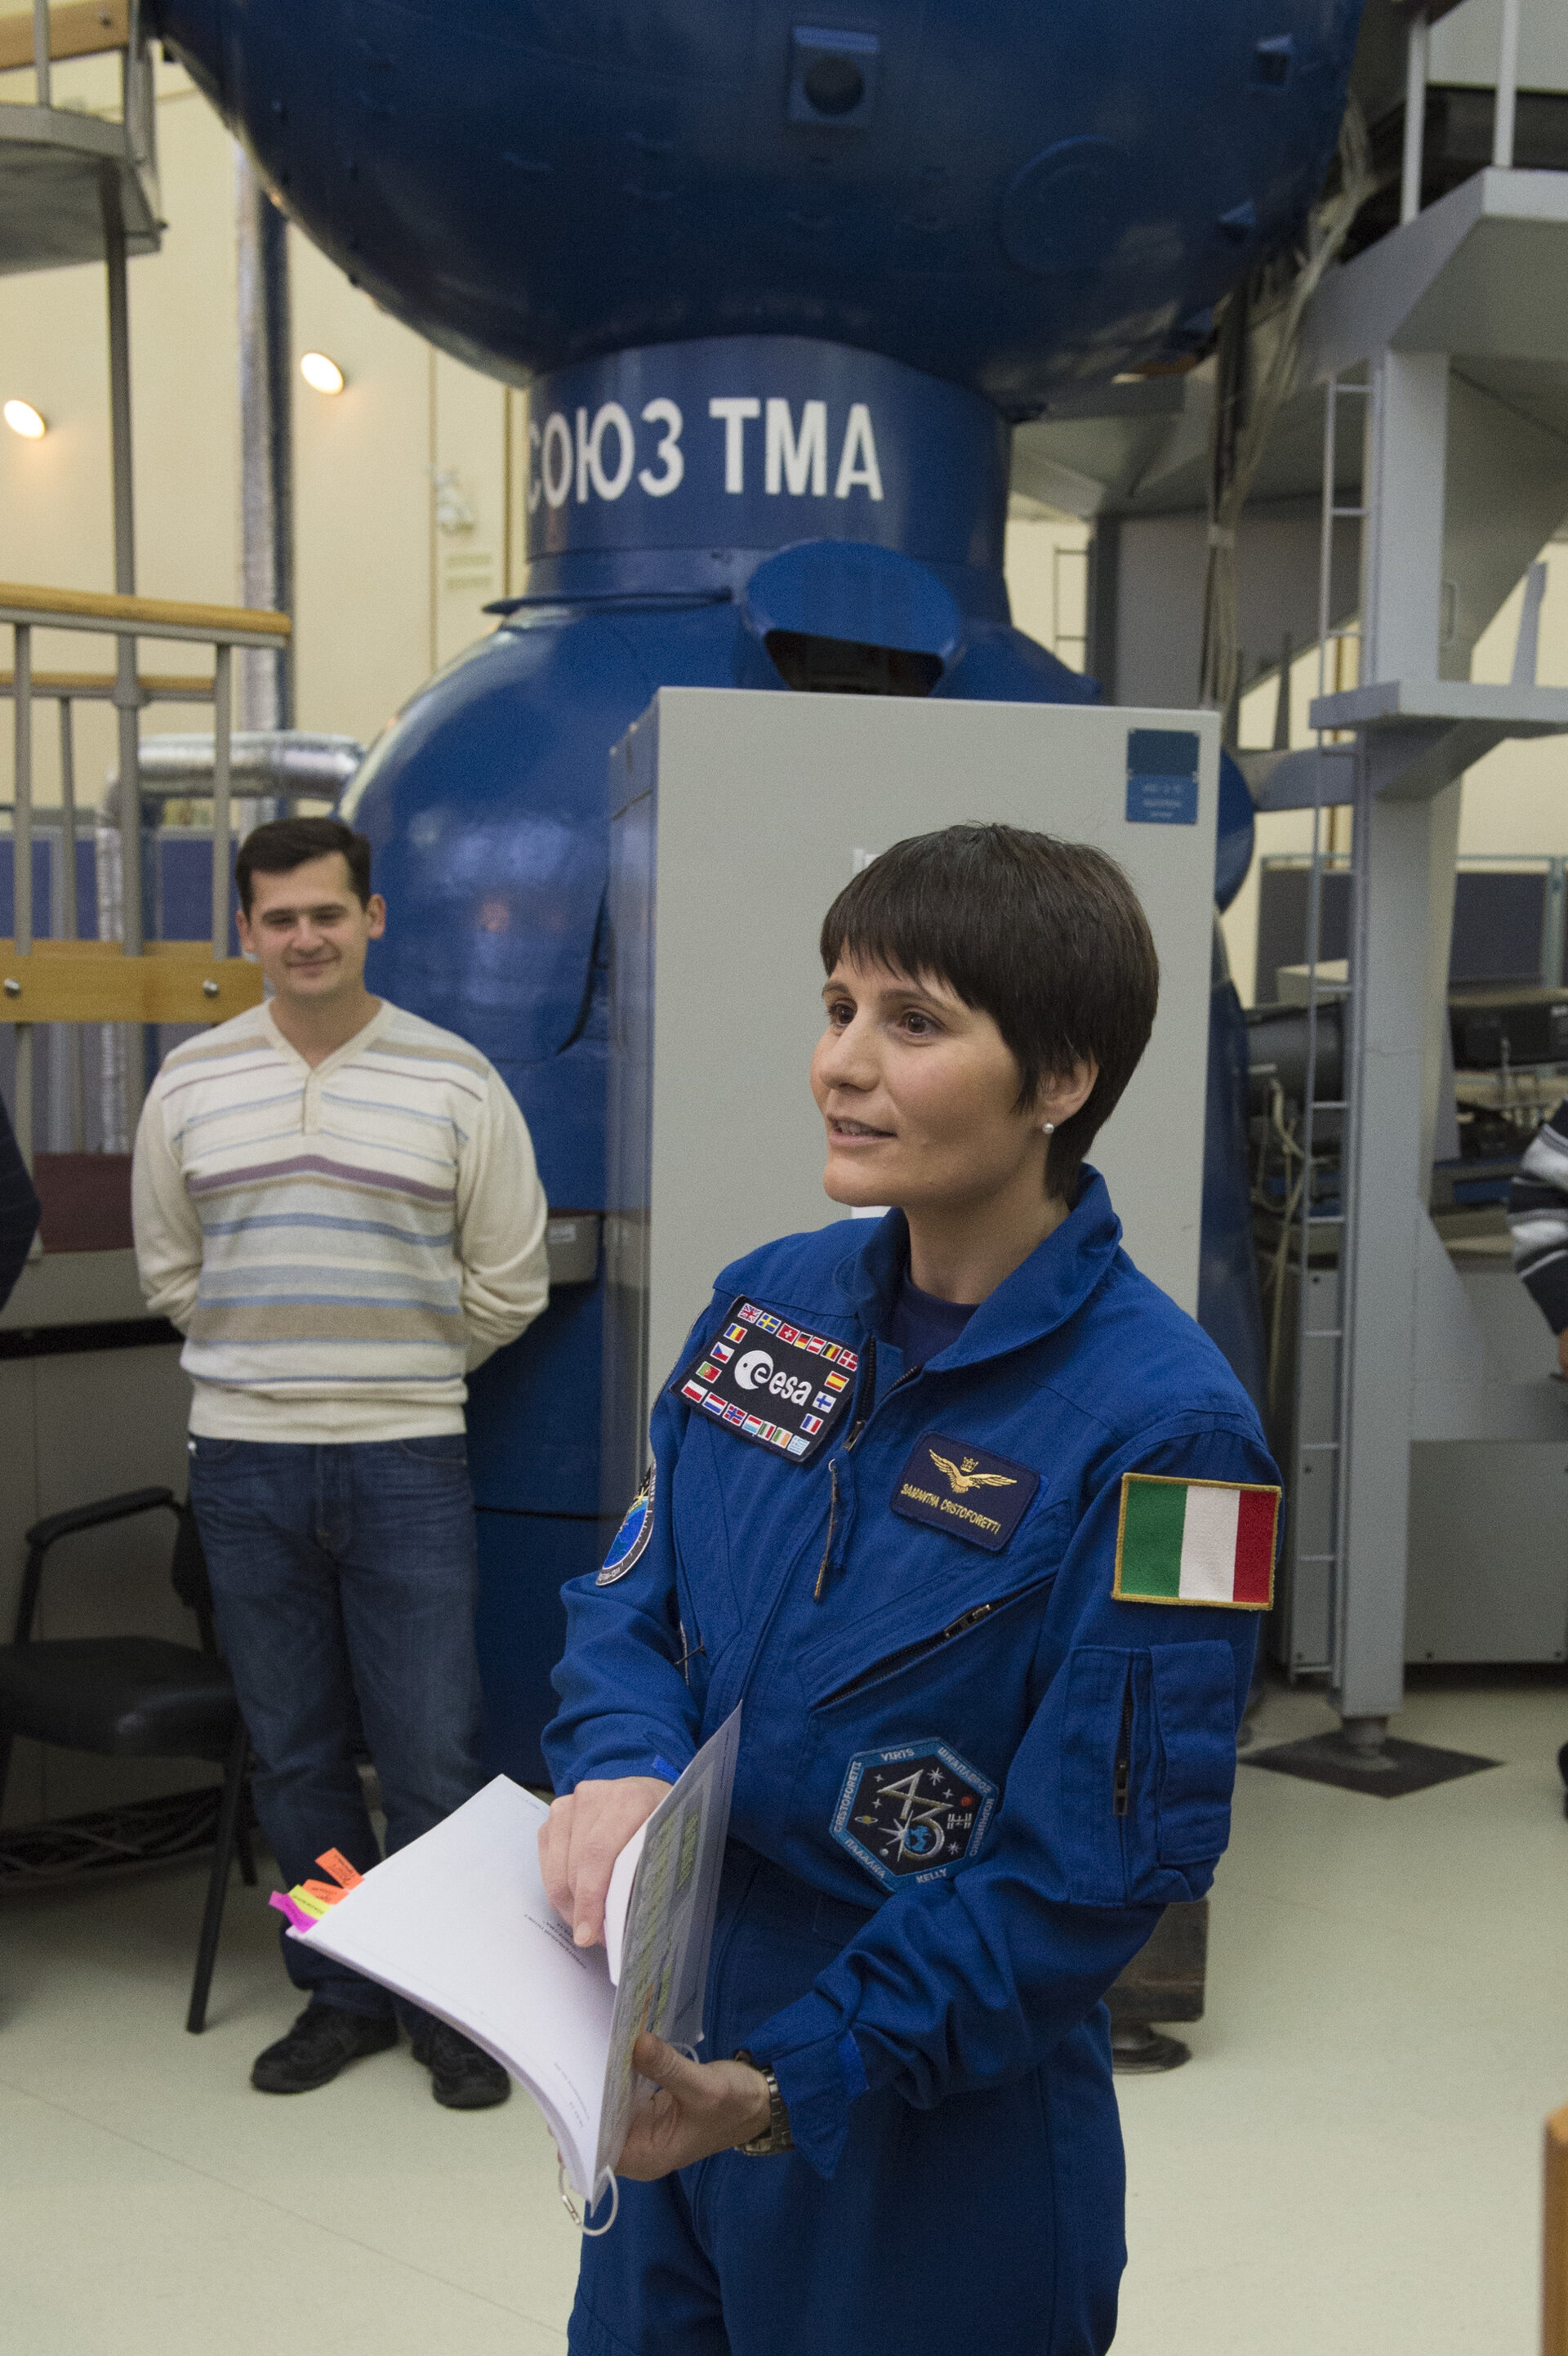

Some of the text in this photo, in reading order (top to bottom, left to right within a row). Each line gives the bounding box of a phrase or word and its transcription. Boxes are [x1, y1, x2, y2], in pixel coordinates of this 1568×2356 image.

[709, 398, 884, 501] ТМА
[900, 1483, 1001, 1535] SAMANTHA CRISTOFORETTI
[880, 1747, 915, 1762] VIRTS
[833, 1761, 862, 1833] CRISTOFORETTI
[915, 1867, 948, 1884] KELLY
